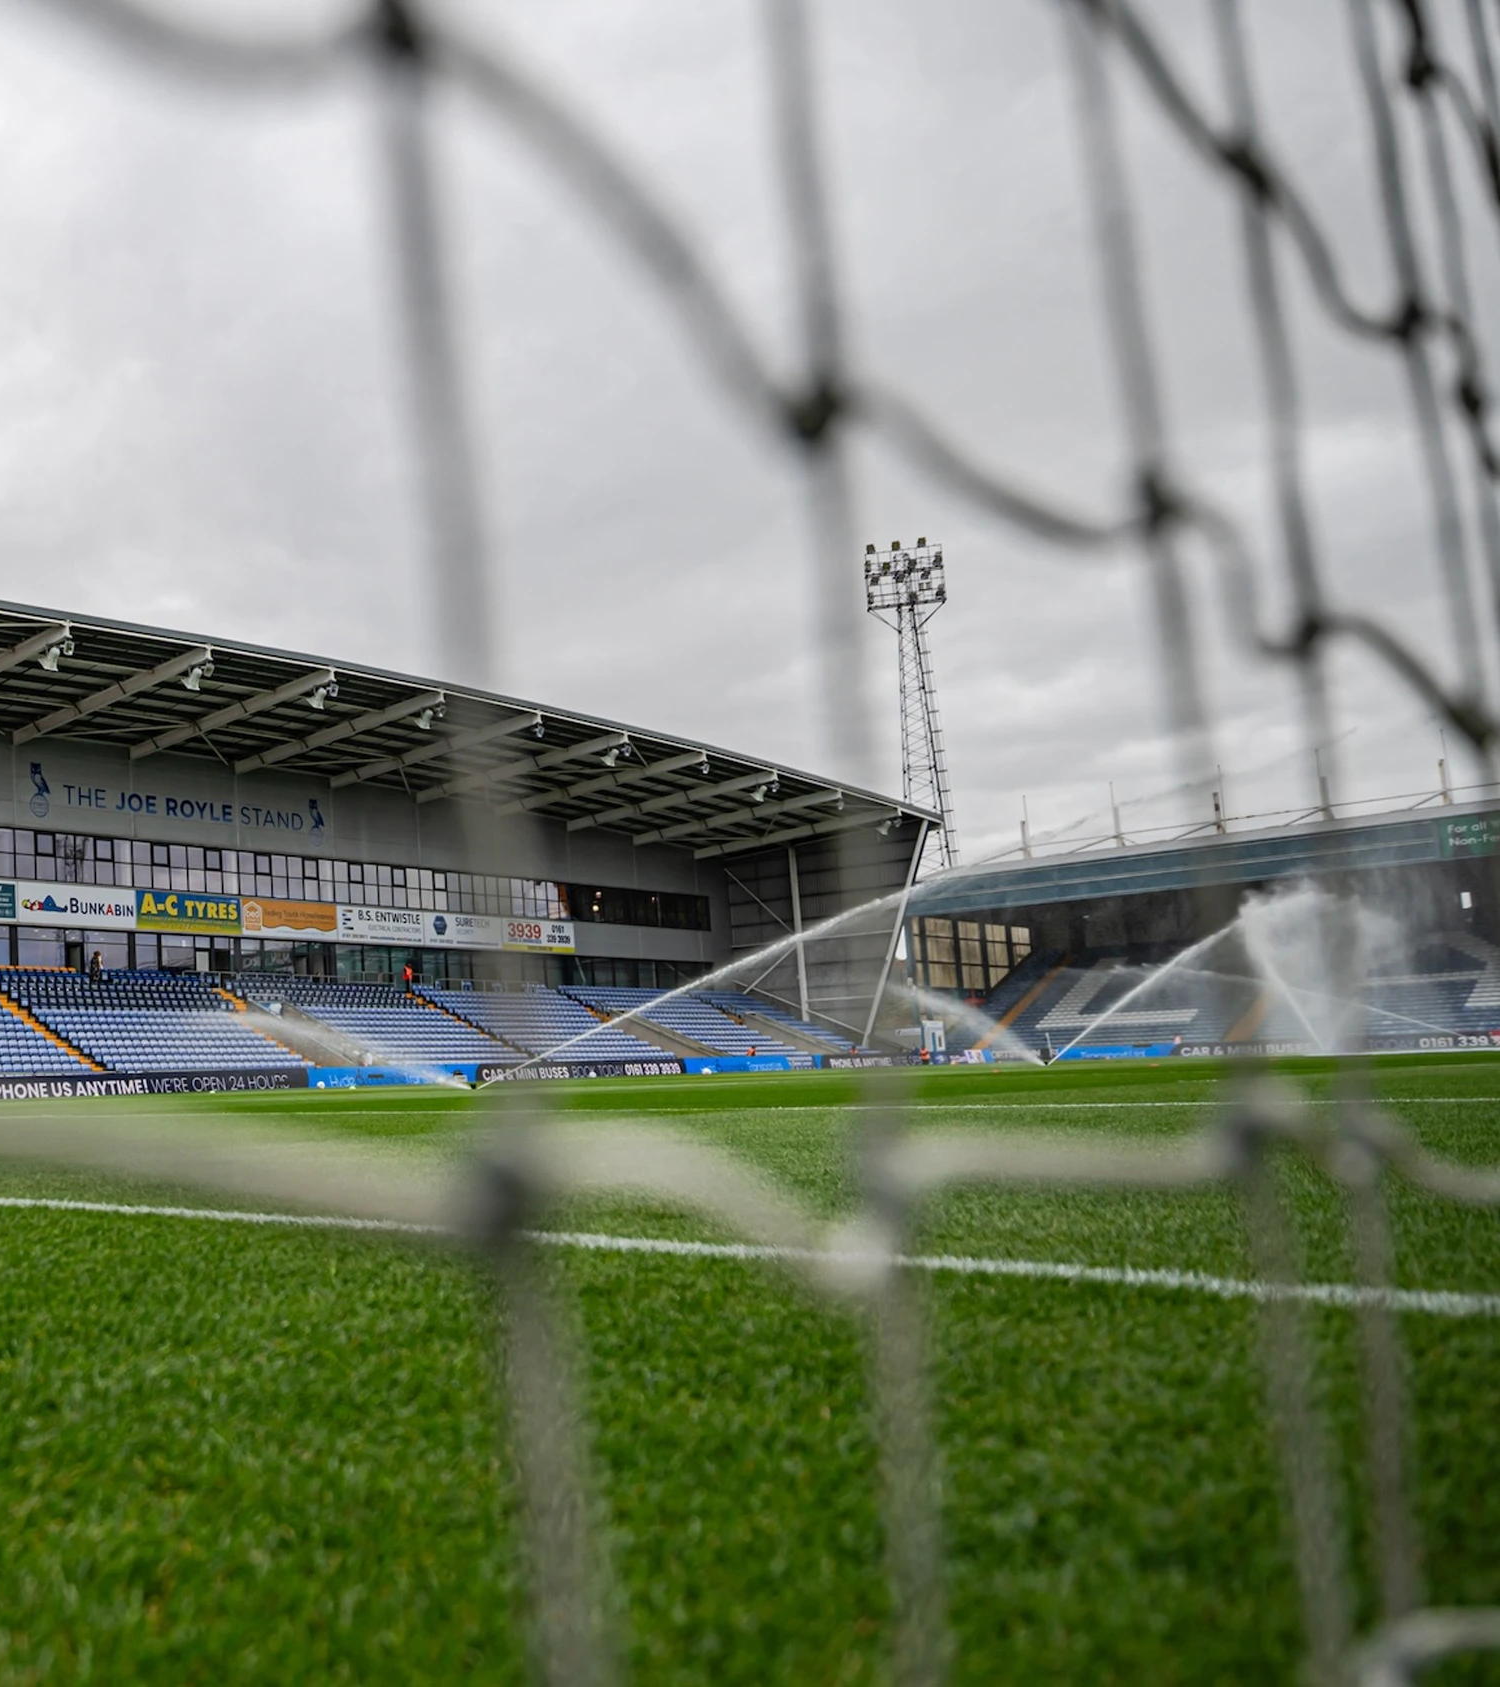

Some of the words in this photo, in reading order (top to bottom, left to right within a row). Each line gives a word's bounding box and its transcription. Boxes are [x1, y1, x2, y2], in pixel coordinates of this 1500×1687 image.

[63, 785, 106, 808] THE
[116, 793, 156, 814] JOE
[165, 798, 233, 822] ROYLE
[240, 806, 303, 830] STAND
[1447, 824, 1468, 834] For
[1471, 821, 1487, 831] all
[69, 898, 134, 916] BUNKABIN
[141, 892, 178, 916] A-C
[184, 900, 238, 920] TYRES
[358, 910, 374, 922] B.S.
[375, 911, 420, 924] ENTWISTLE
[508, 922, 542, 940] 3939
[1420, 1037, 1454, 1048] 0161
[1458, 1036, 1488, 1047] 339
[1180, 1046, 1210, 1057] CAR
[1213, 1046, 1224, 1056] &
[515, 1068, 538, 1080] MINI
[540, 1066, 570, 1080] BUSES
[624, 1064, 643, 1076] 0161
[644, 1063, 659, 1075] 339
[660, 1062, 681, 1074] 3939
[52, 1082, 72, 1097] US
[76, 1078, 149, 1096] ANYTIME!
[150, 1078, 189, 1093] WE'RE
[192, 1076, 226, 1092] OPEN
[228, 1075, 246, 1091] 24
